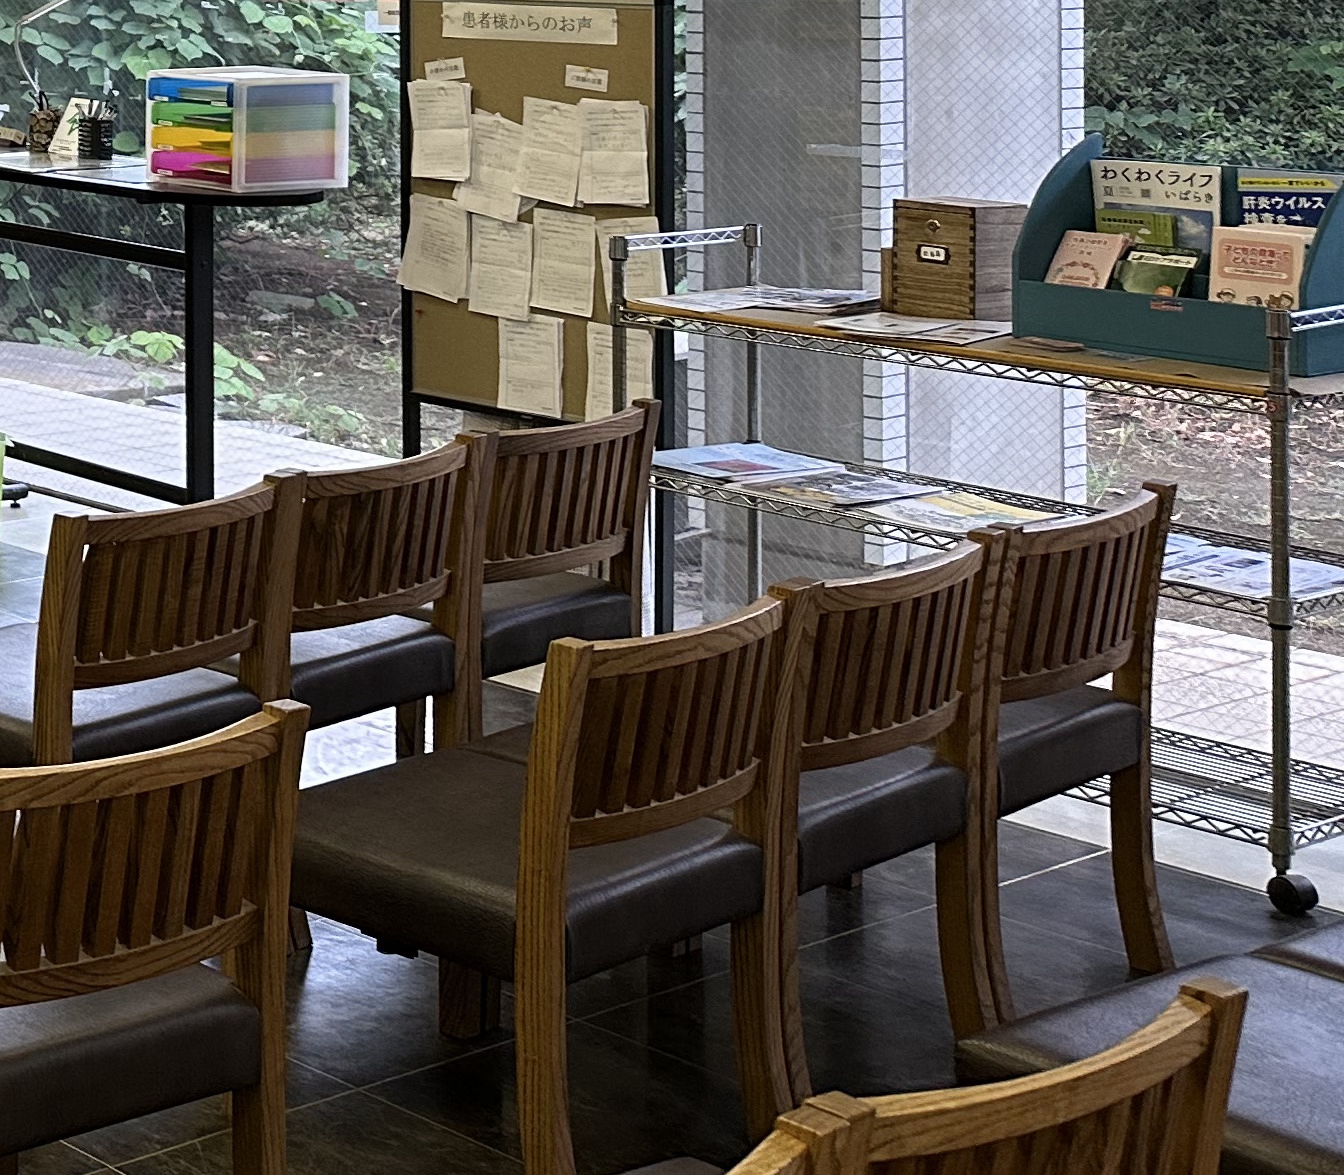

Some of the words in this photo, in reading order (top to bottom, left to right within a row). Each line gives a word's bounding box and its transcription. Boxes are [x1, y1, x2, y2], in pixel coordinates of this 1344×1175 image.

[462, 10, 593, 33] 患者様からのお声
[1100, 165, 1214, 188] わくわくライフ
[1164, 189, 1214, 204] いばらき
[1241, 195, 1327, 210] 肝炎ウイルス
